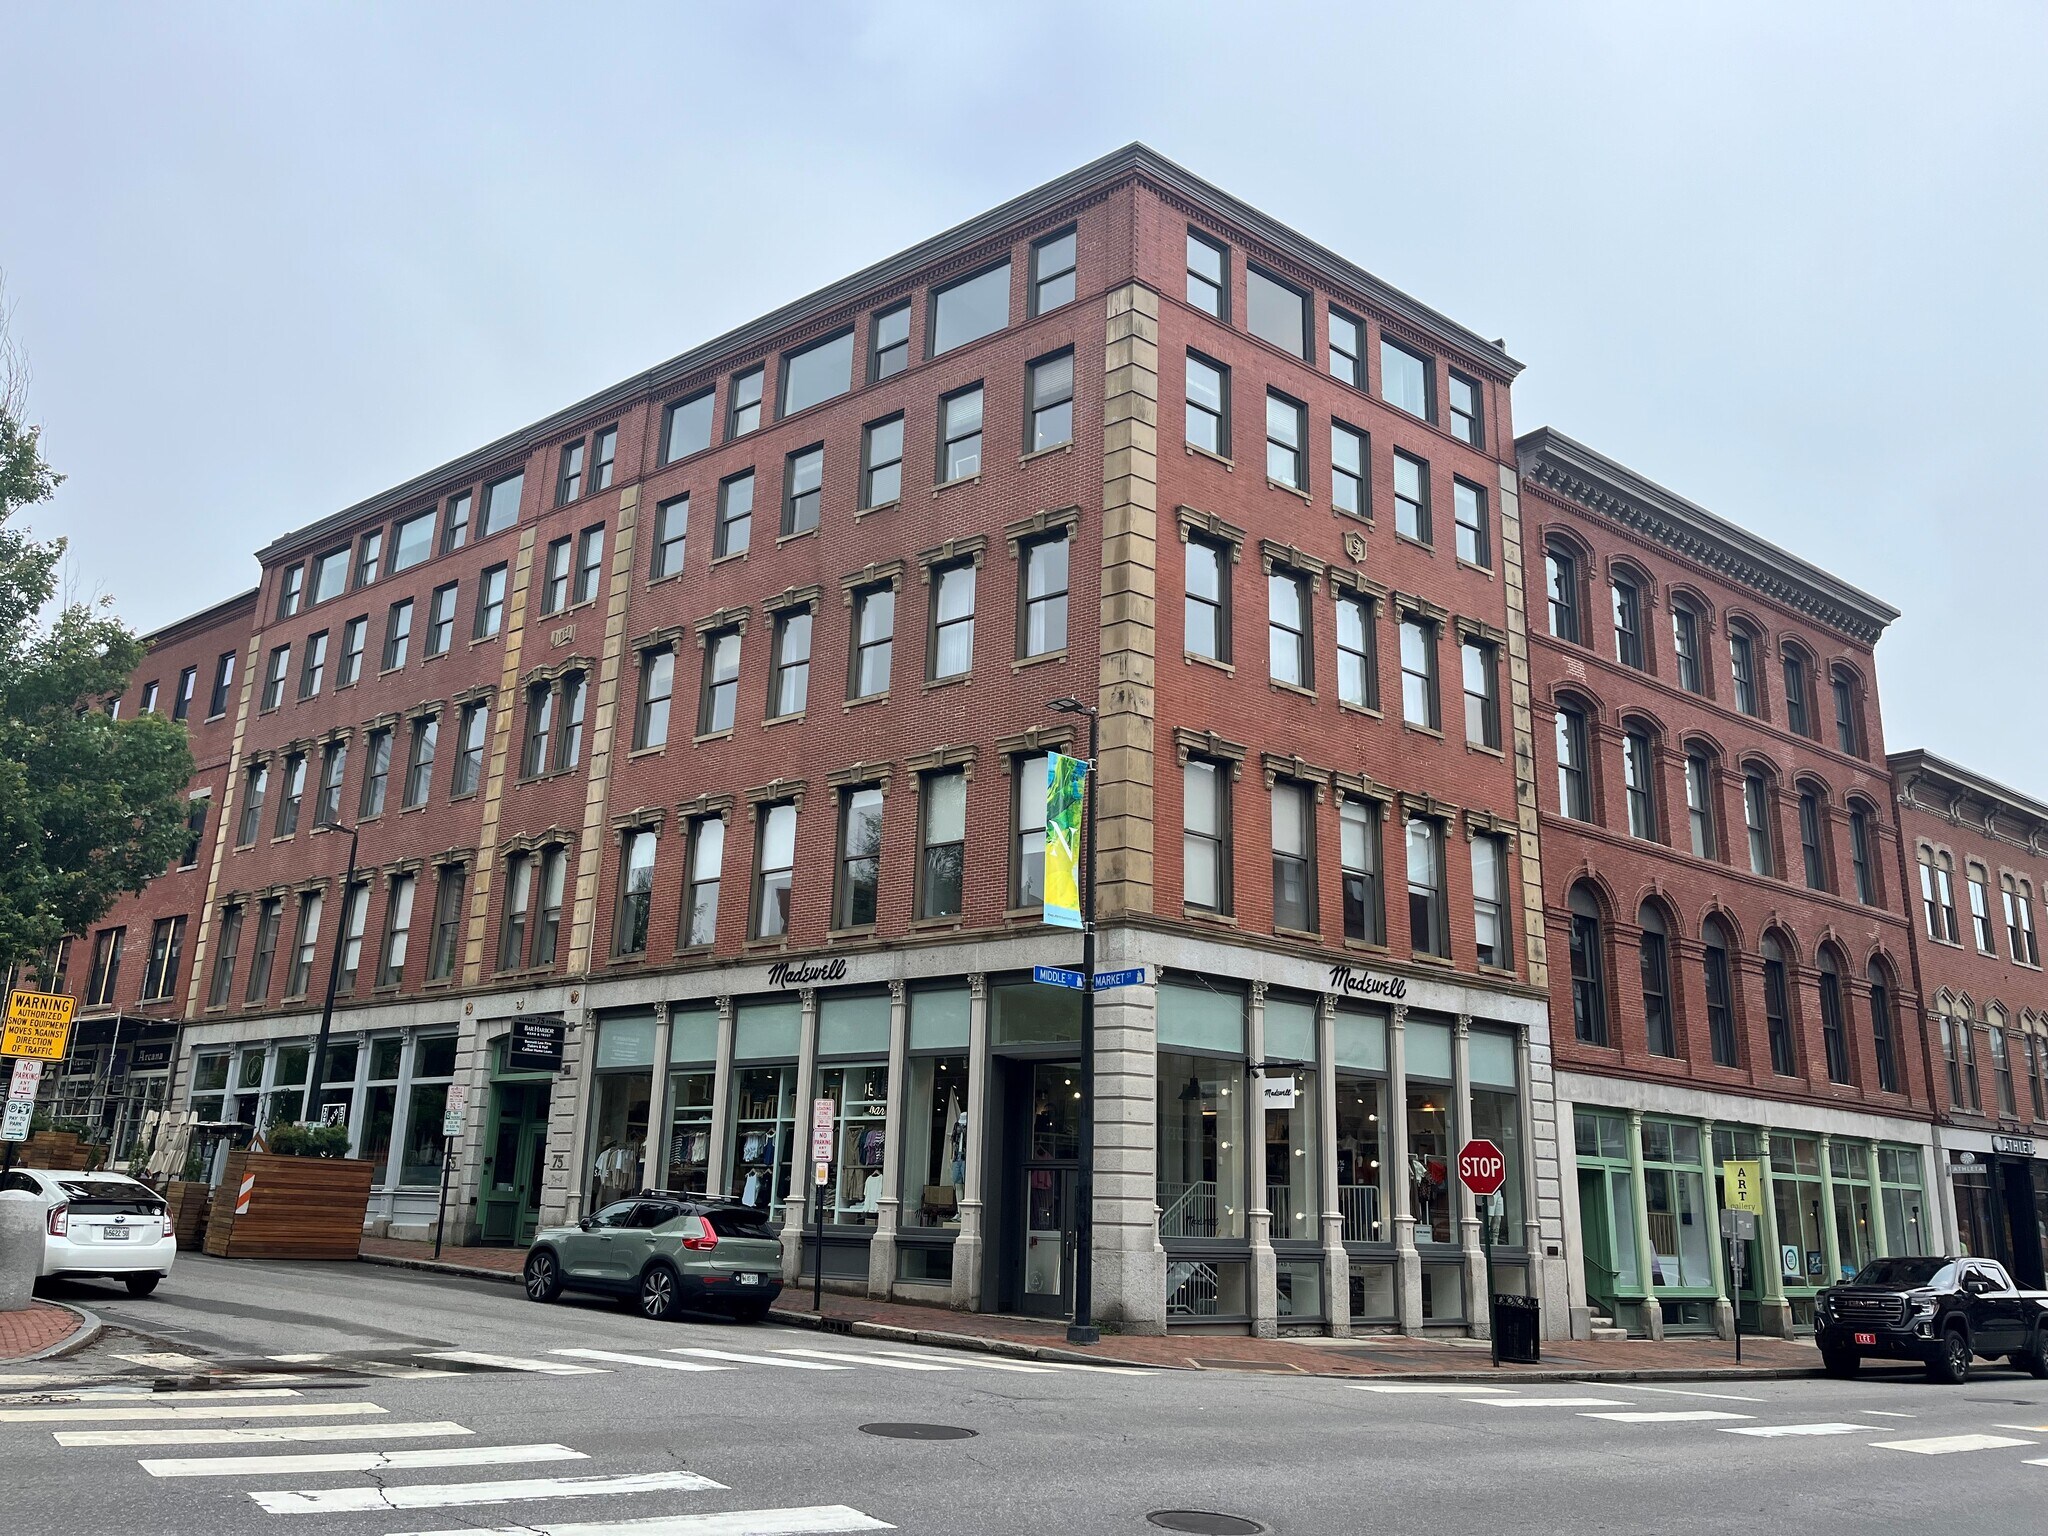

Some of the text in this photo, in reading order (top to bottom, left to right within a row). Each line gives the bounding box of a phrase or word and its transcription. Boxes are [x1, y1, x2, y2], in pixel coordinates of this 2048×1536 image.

[768, 959, 847, 989] Madewell
[1039, 968, 1067, 984] MIDDLE
[1095, 973, 1125, 987] MARKET
[1328, 965, 1407, 999] Madewell
[15, 994, 70, 1013] WARNING
[17, 1009, 63, 1020] AUTHORIZED
[7, 1016, 68, 1030] SNOW EQUIPMENT
[8, 1026, 64, 1039] MOVES AGAINST
[15, 1035, 53, 1046] DIRECTION
[11, 1044, 53, 1056] OF TRAFFIC
[138, 1050, 164, 1062] Arcana
[22, 1063, 34, 1071] NO
[14, 1071, 39, 1081] PARKING
[552, 1154, 564, 1169] 75
[1461, 1156, 1501, 1178] STOP
[1737, 1167, 1747, 1202] ART
